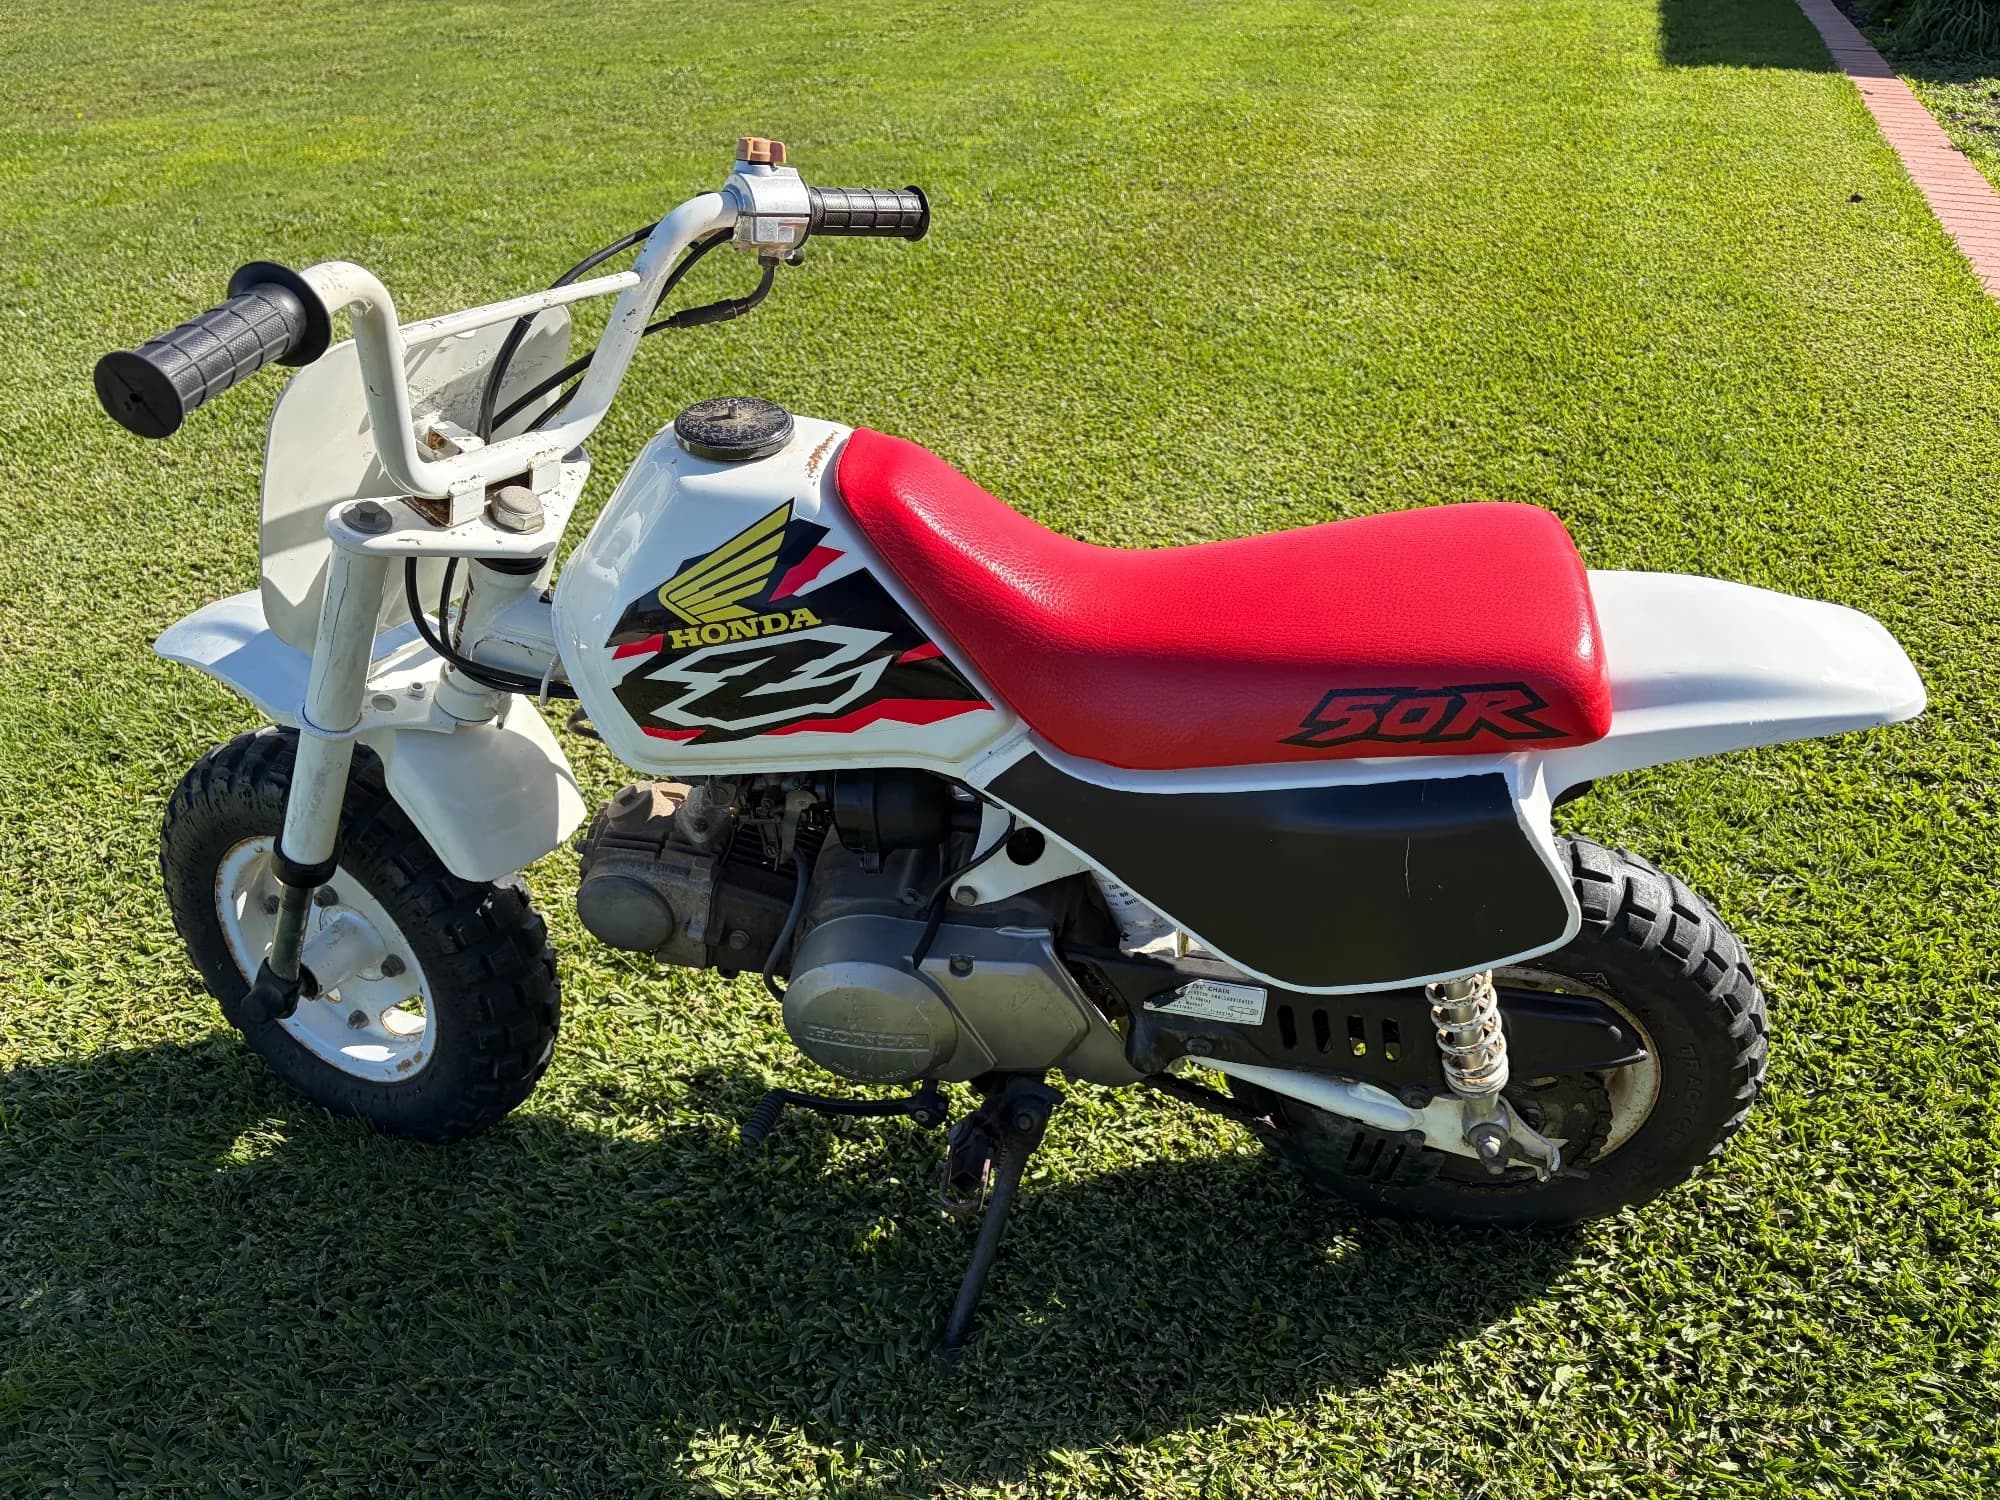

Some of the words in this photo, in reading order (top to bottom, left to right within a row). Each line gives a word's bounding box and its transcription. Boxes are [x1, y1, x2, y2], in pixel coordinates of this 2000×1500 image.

[667, 607, 821, 650] HONDA
[1284, 684, 1566, 746] 50R
[808, 1025, 924, 1048] HONDA
